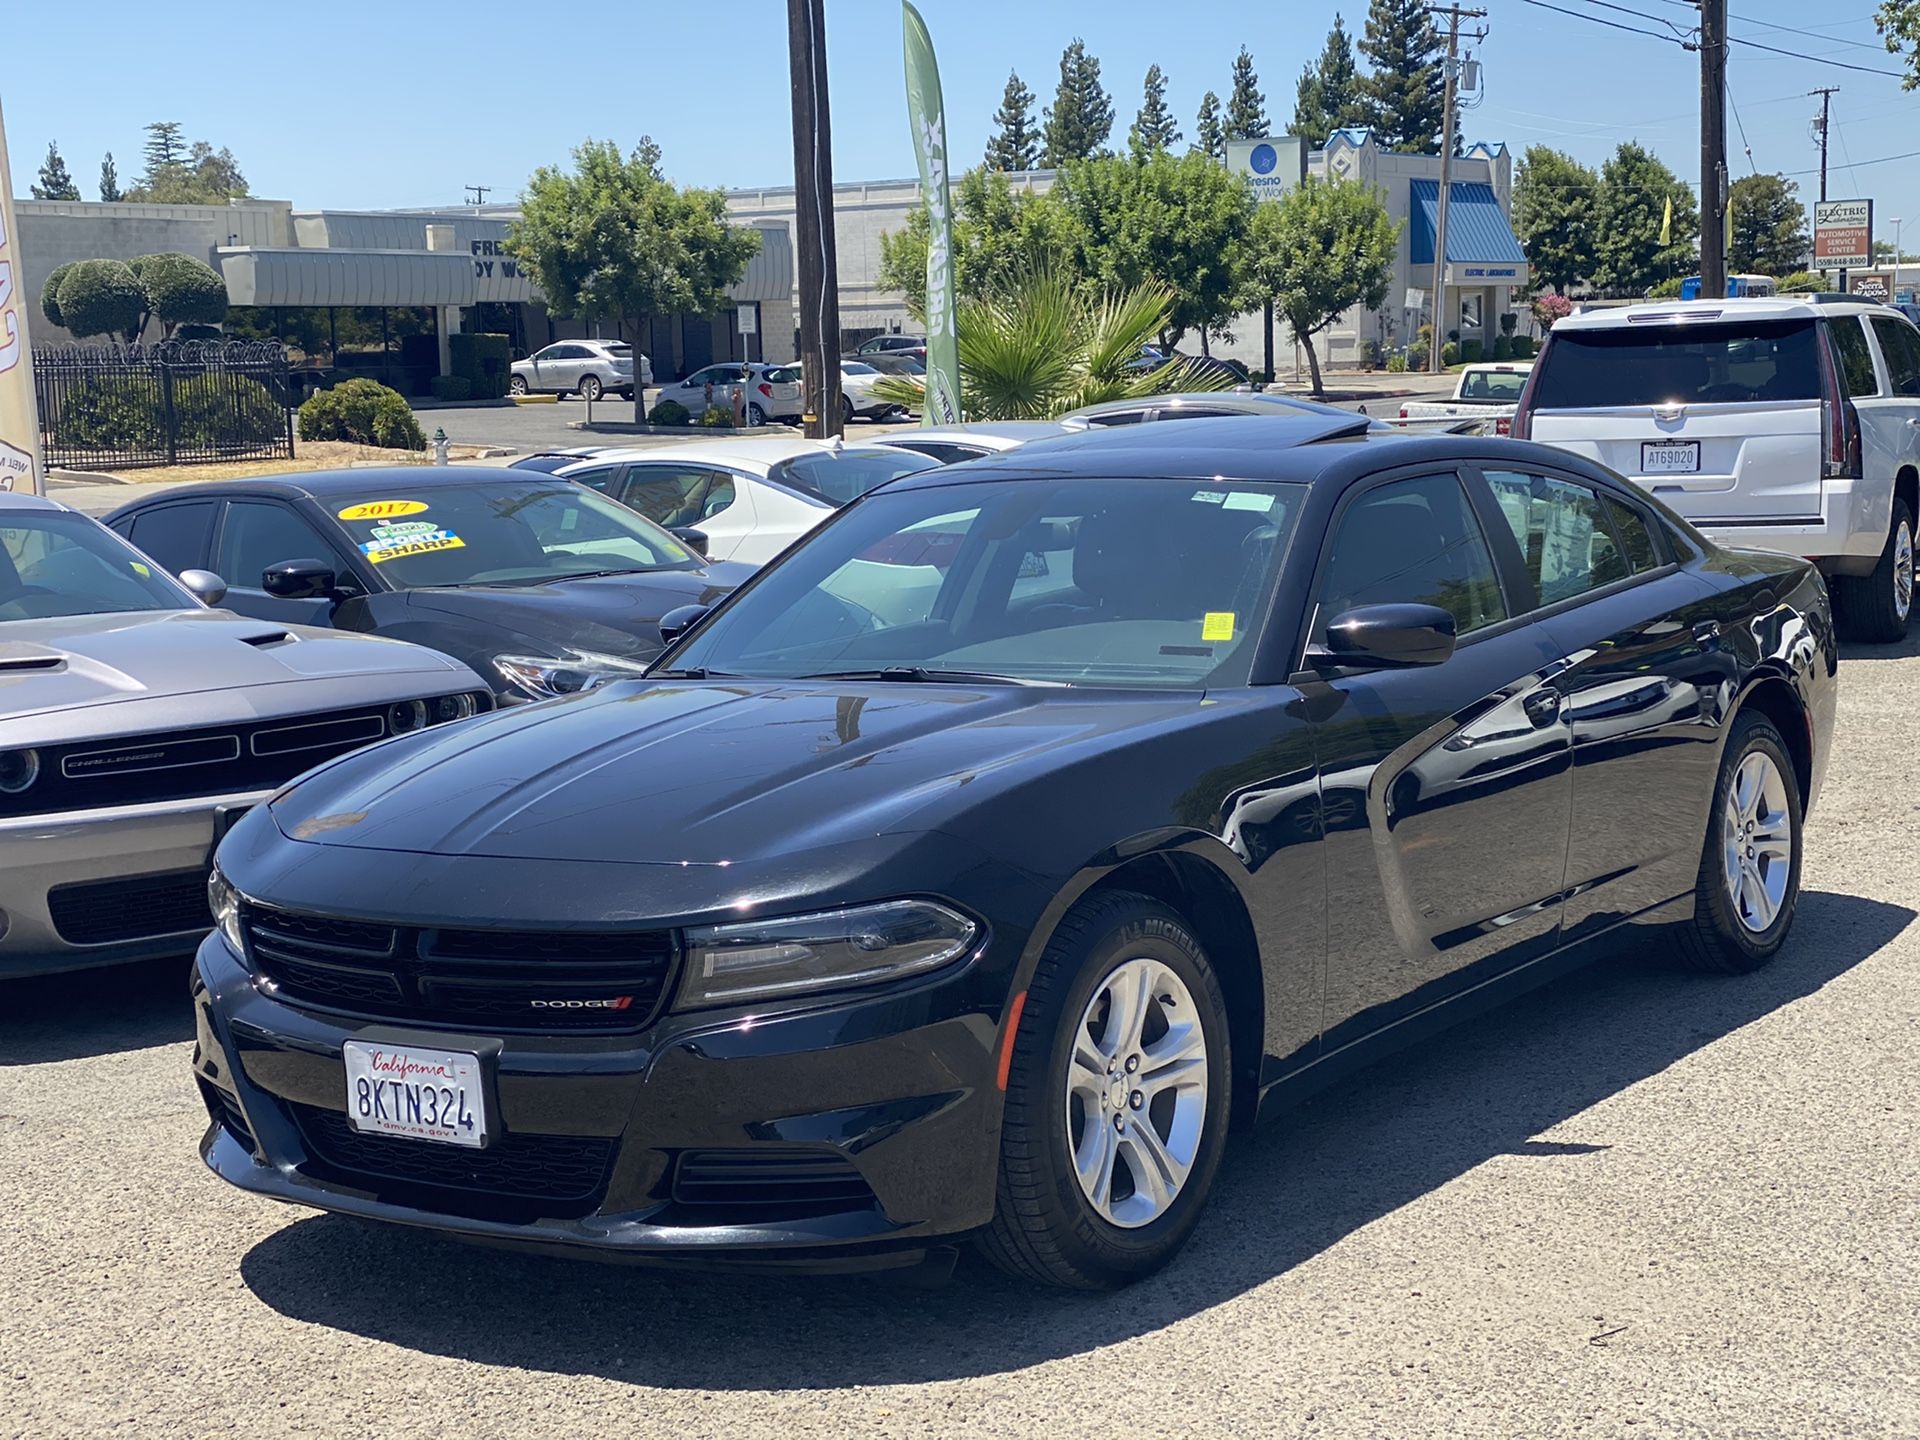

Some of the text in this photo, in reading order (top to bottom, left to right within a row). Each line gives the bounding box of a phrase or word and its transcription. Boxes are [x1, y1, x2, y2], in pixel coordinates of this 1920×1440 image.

[1818, 207, 1866, 217] ELECTRIC
[1817, 230, 1866, 238] AUTOMOTIVE
[471, 240, 505, 256] FRE
[1828, 246, 1855, 254] CENTER
[1648, 450, 1693, 464] AT69D20
[356, 502, 411, 517] 2017
[366, 530, 447, 550] SPORTY
[377, 538, 453, 559] SHARP
[67, 751, 165, 768] CHALLENGER
[1144, 919, 1211, 979] MICHELIN
[531, 999, 619, 1009] DODGE
[372, 1051, 455, 1079] California
[357, 1077, 474, 1131] 8KTN324
[384, 1121, 450, 1137] dmv.ca.gov
